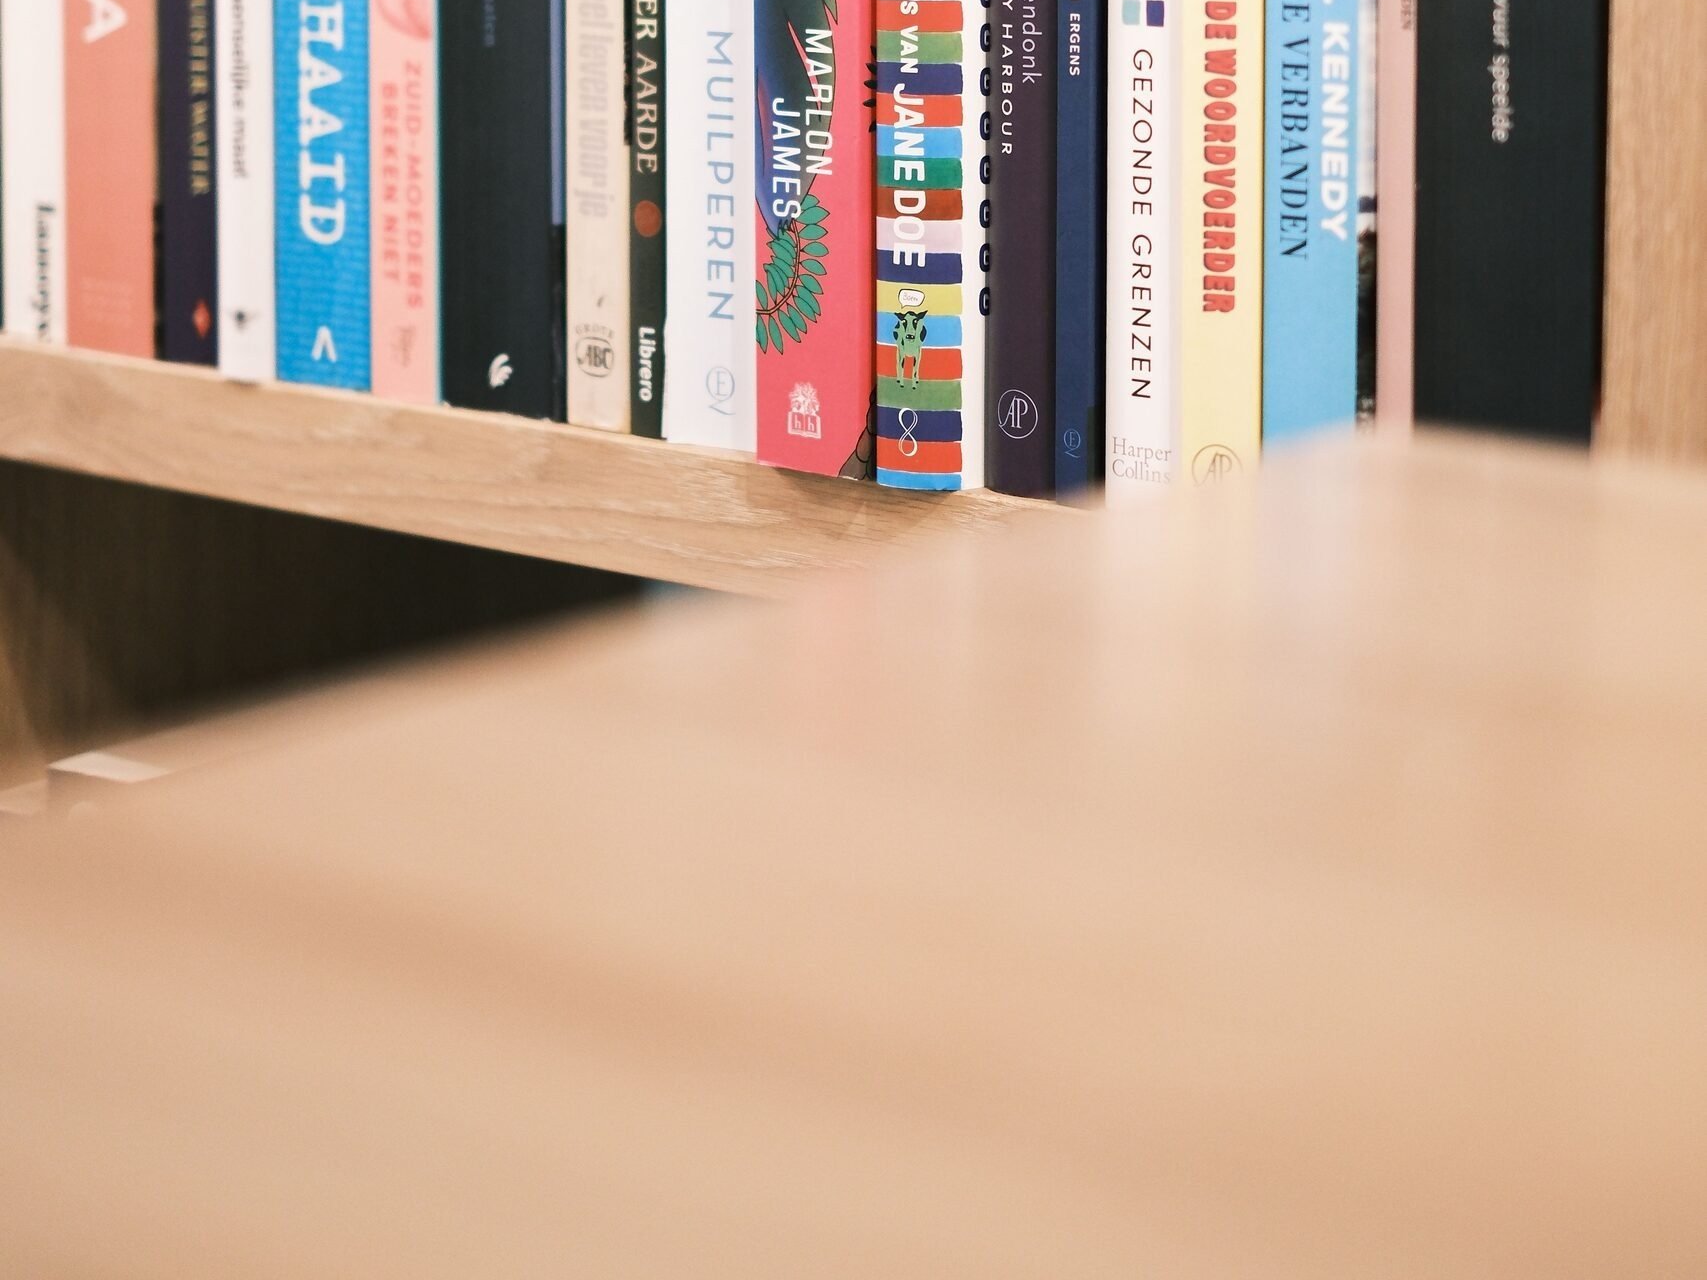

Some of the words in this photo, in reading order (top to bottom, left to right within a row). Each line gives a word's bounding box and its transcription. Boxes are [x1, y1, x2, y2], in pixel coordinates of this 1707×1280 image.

[900, 24, 919, 74] VAN
[1069, 13, 1081, 76] ERGENS
[1204, 0, 1237, 39] DE
[577, 32, 614, 113] leven
[636, 53, 658, 173] AARDE
[805, 29, 833, 175] MARLON
[1001, 24, 1013, 155] HARBOUR
[1487, 54, 1513, 143] speelde
[381, 82, 400, 202] BREKEN
[577, 119, 611, 187] voor
[706, 30, 735, 321] MUILPEREN
[772, 97, 801, 219] JAMES
[893, 83, 925, 182] JANE
[1132, 49, 1153, 215] GEZONDE
[1279, 35, 1310, 260] VERBANDEN
[1321, 21, 1350, 241] KENNEDY
[404, 61, 423, 310] ZUID-MOEDERS
[574, 187, 614, 218] je
[892, 189, 926, 267] DOE
[1203, 49, 1237, 313] WOORDVOERDER
[382, 214, 400, 283] NIET
[639, 326, 656, 402] Librero
[1131, 234, 1152, 399] GRENZEN
[1112, 436, 1172, 464] Harper
[1112, 459, 1171, 484] Collins
